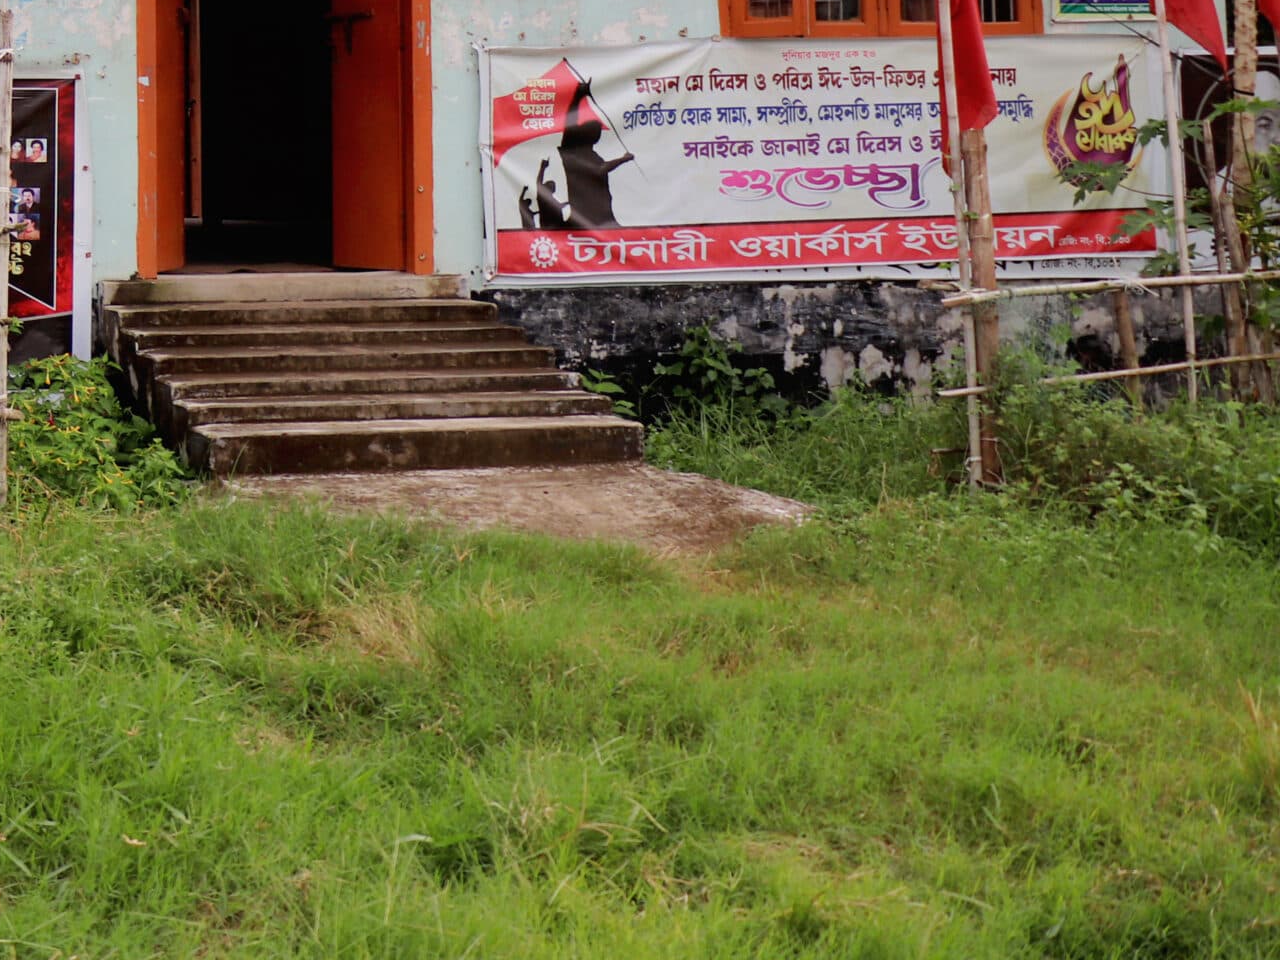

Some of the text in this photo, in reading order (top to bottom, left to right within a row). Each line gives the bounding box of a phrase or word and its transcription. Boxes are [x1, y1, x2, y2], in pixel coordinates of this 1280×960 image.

[635, 75, 680, 94] মহান
[685, 74, 704, 92] মে
[709, 68, 748, 92] দিবস
[754, 74, 767, 90] ও
[772, 66, 813, 91] পবিত্র
[623, 100, 677, 131] প্রতিষ্ঠিত
[681, 106, 712, 126] হোক
[818, 97, 870, 122] মেহনতি
[874, 101, 923, 128] মানুষের
[682, 135, 754, 160] সবাইকে
[760, 133, 820, 157] জানাই
[827, 137, 850, 155] মে
[856, 130, 902, 154] দিবস
[909, 137, 924, 154] ও
[1075, 126, 1137, 154] মোবারক
[718, 163, 927, 210] শুভেচ্ছা
[566, 222, 889, 265] ট্যানারী ওয়ার্কার্স
